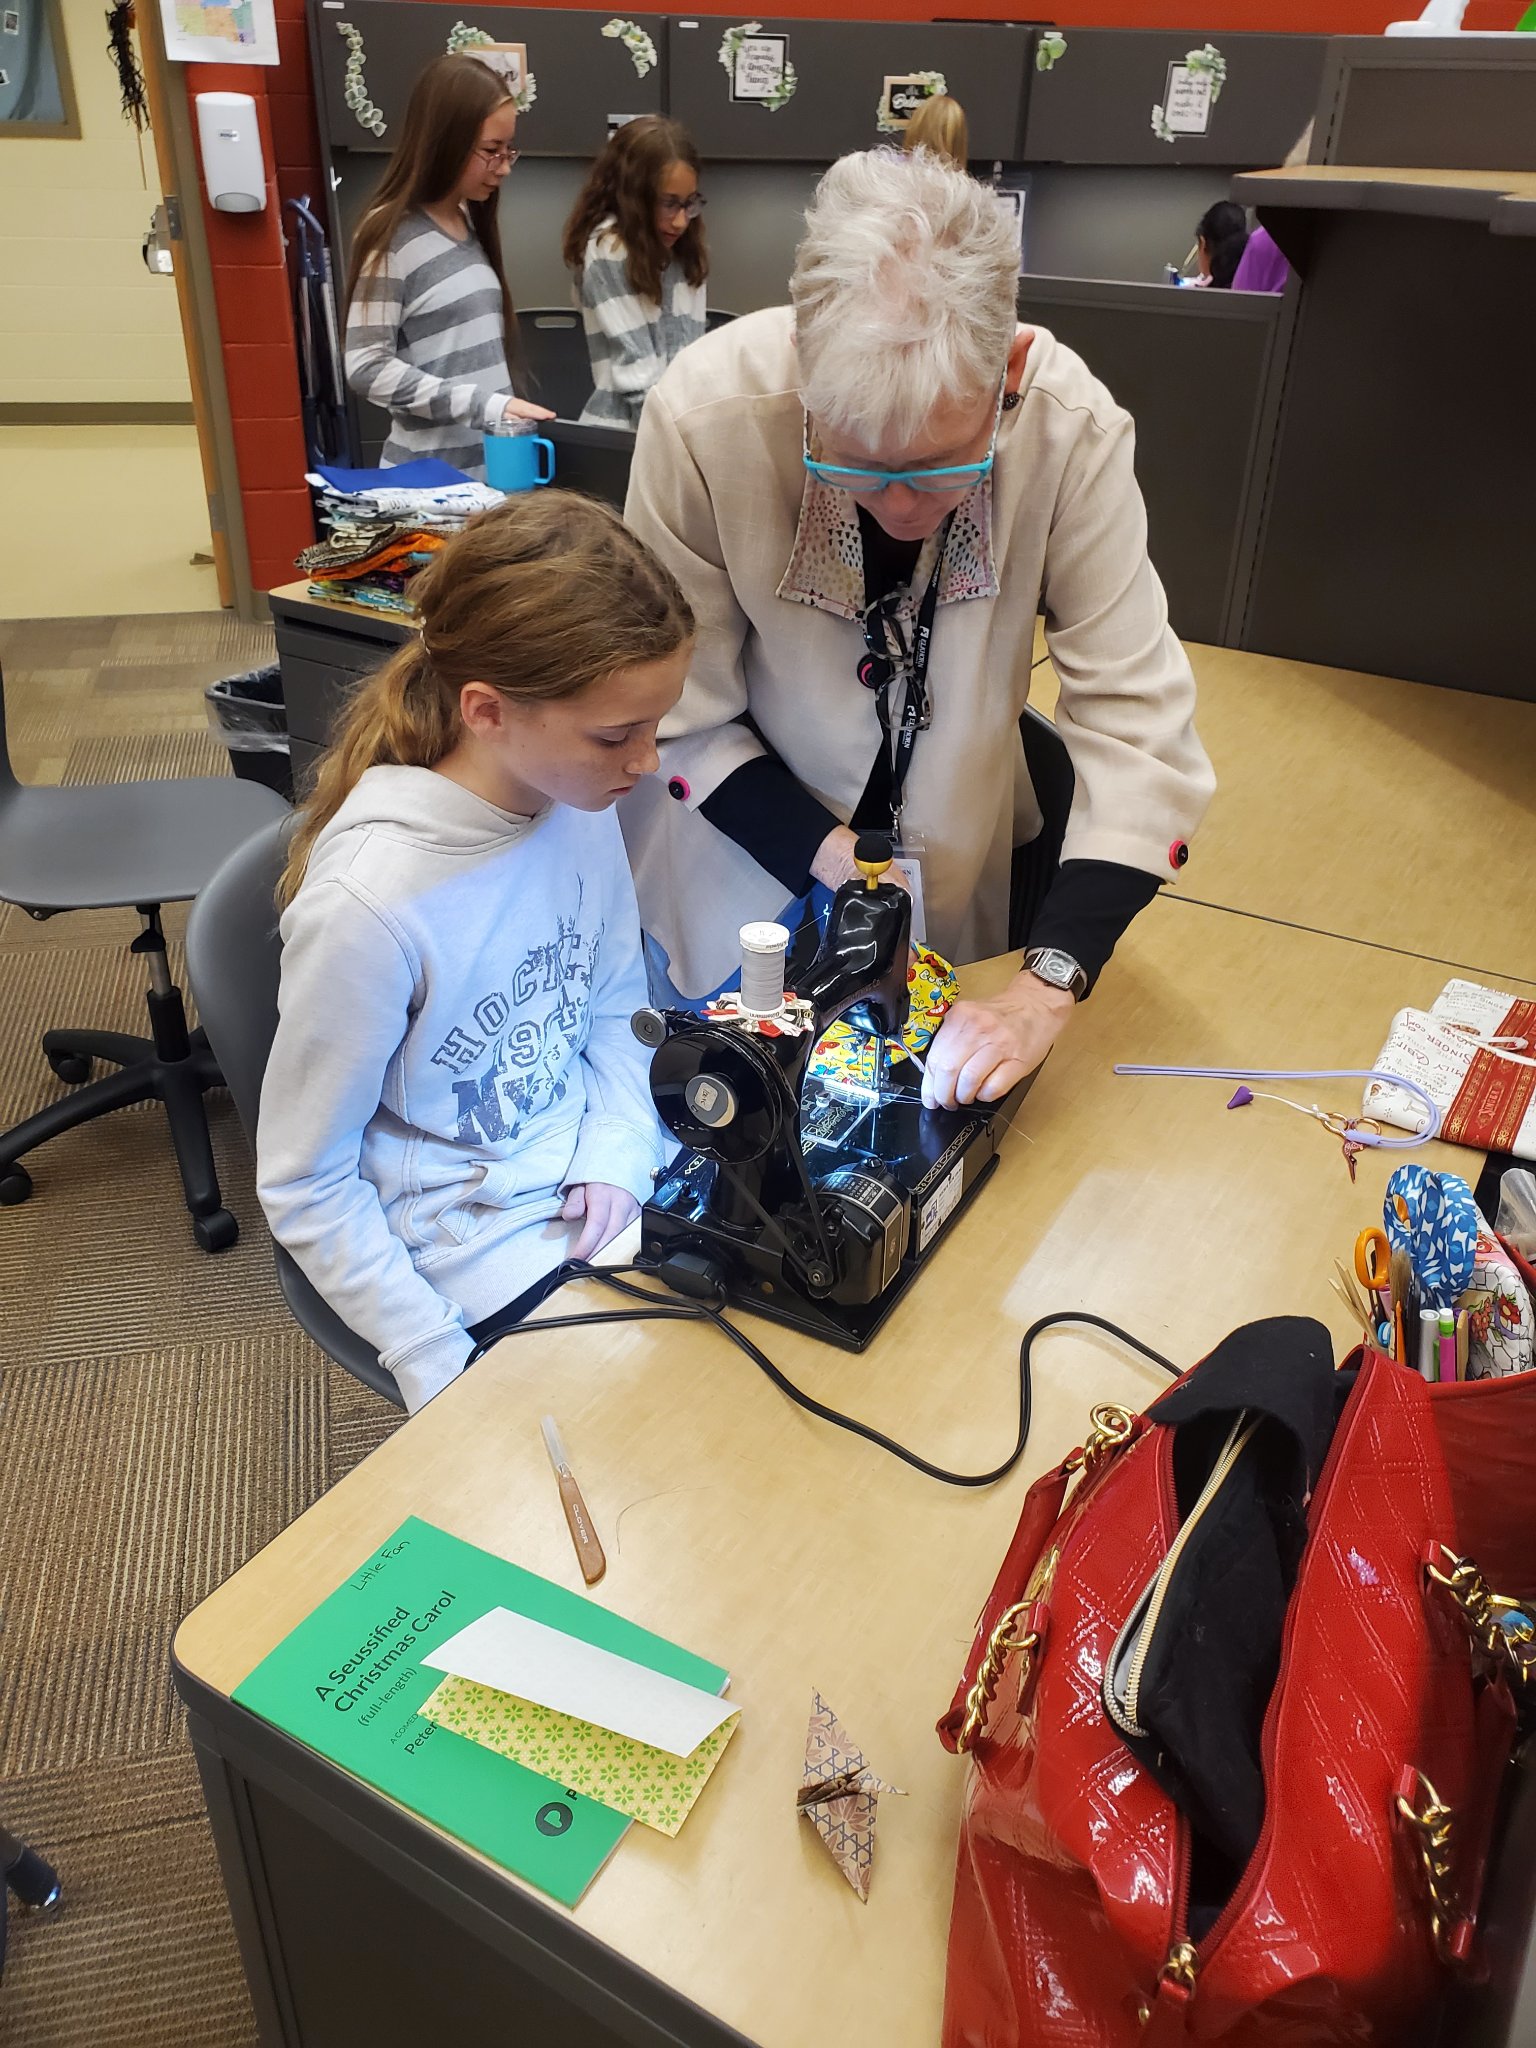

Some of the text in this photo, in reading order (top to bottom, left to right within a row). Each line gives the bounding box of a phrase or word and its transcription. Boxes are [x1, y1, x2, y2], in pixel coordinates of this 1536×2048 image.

[917, 635, 930, 669] ELKHORN
[903, 714, 917, 750] ELHORN
[1427, 1034, 1473, 1065] SINGER
[1478, 1090, 1500, 1117] SINGER
[572, 1503, 589, 1544] CLOVER
[350, 1540, 411, 1591] Little Fan
[315, 1606, 411, 1702] A Seussified
[334, 1590, 457, 1712] Christmas Carol
[357, 1667, 418, 1727] (full-length)
[390, 1737, 397, 1745] A
[404, 1721, 438, 1755] Peter
